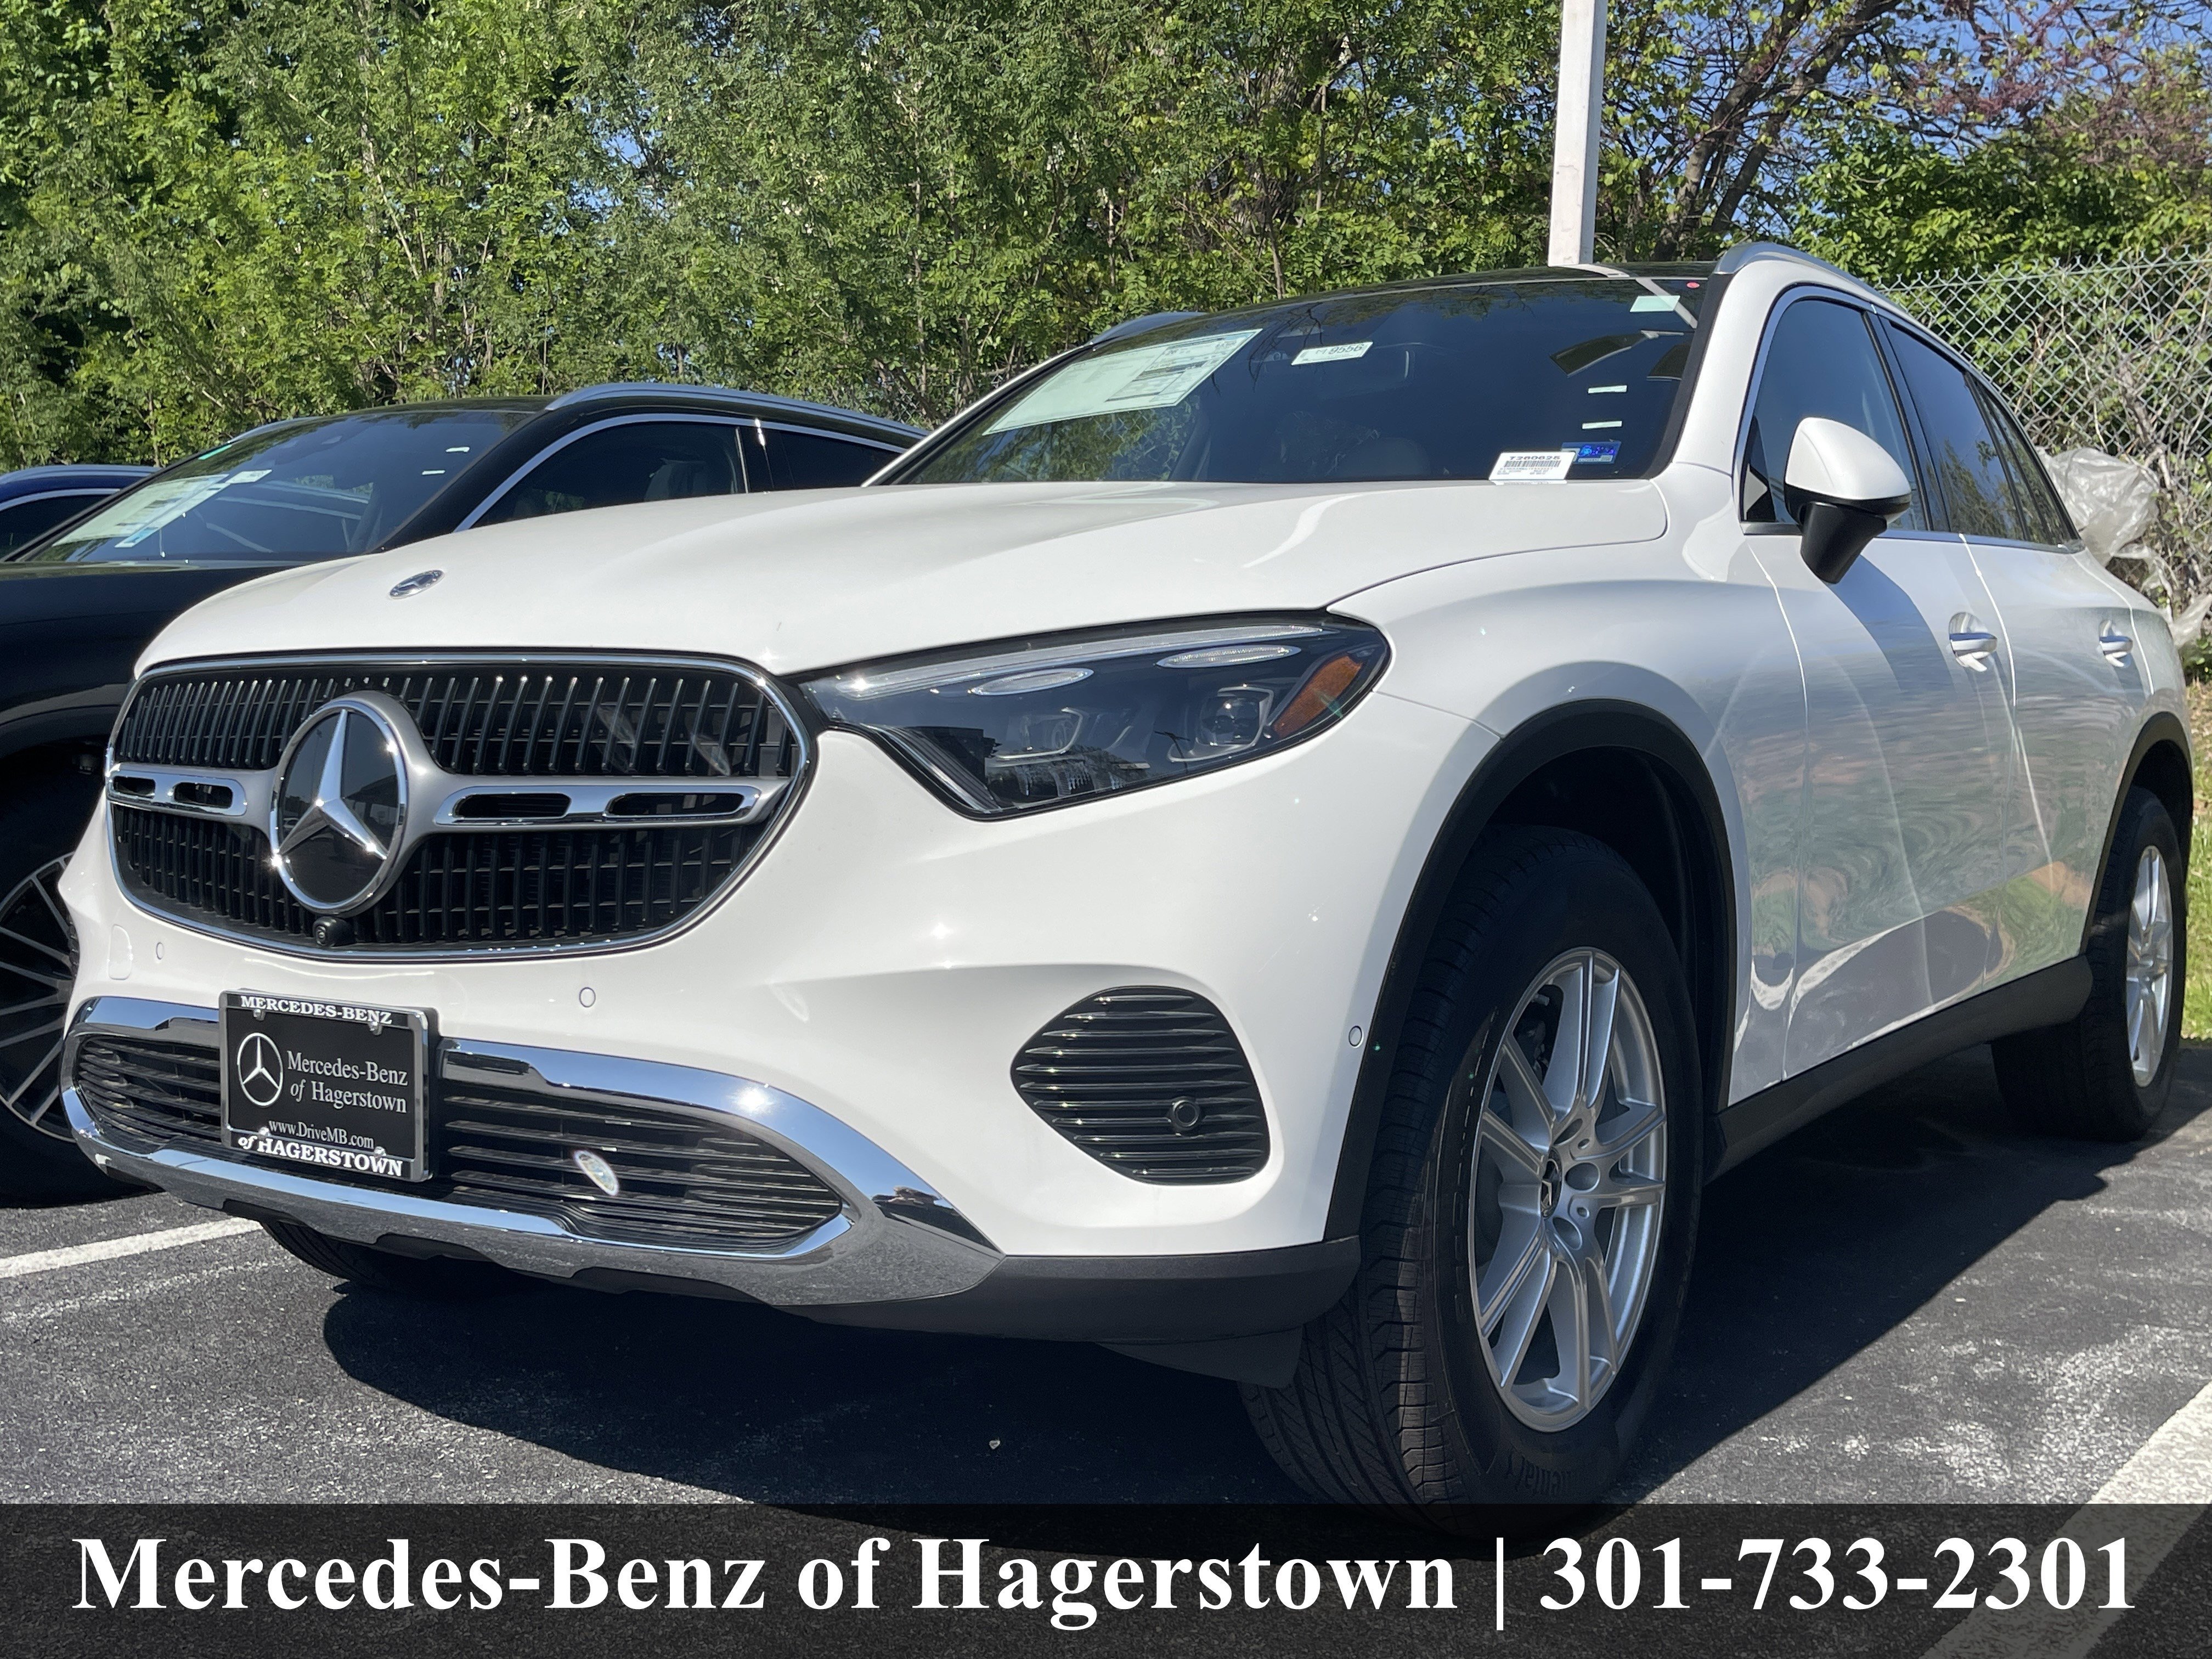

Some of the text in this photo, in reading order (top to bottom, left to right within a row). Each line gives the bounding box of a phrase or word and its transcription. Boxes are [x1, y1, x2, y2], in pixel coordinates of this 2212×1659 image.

[241, 996, 392, 1024] MERCEDES-BENZ
[286, 1050, 408, 1086] Mercedes-Benz
[290, 1079, 408, 1113] of Hagerstown
[268, 1120, 374, 1149] www.DriveMB.com
[238, 1136, 403, 1177] of HAGERSTOWN
